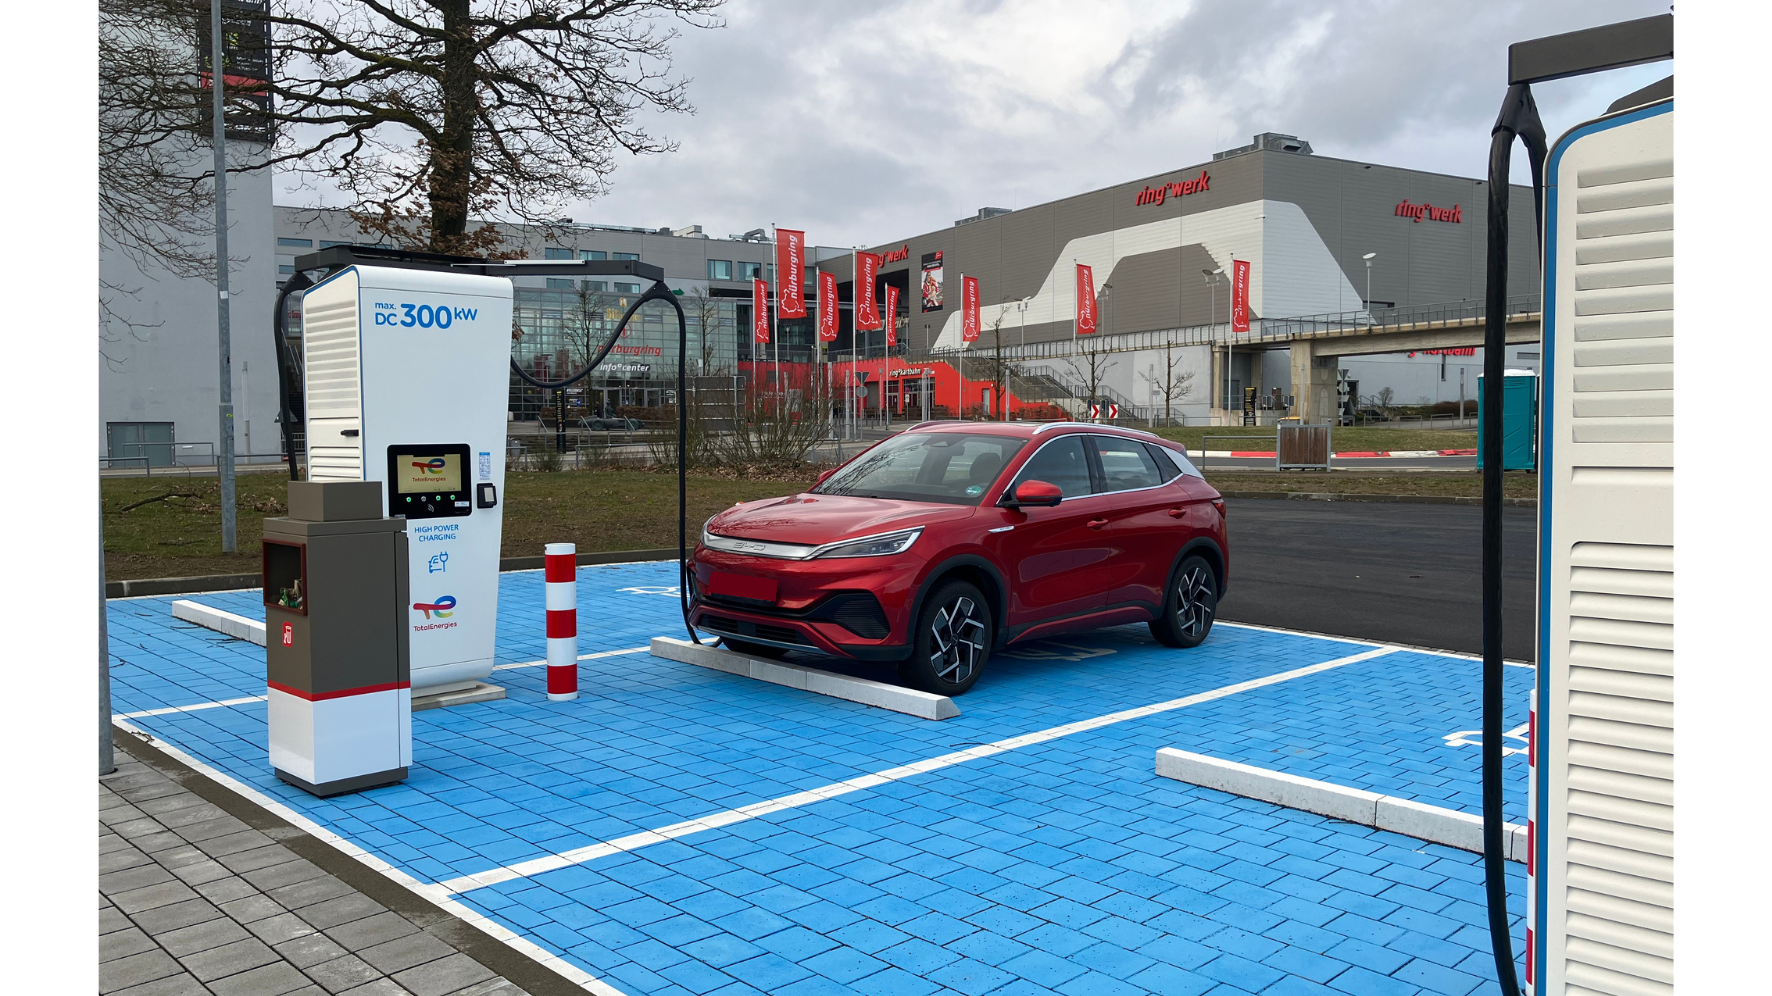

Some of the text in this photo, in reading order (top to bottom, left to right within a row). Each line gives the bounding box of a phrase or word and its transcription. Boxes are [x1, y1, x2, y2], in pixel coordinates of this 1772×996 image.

[788, 234, 799, 300] nürburgring
[374, 302, 397, 310] max.
[826, 276, 835, 327] nürburgring
[375, 303, 478, 329] DC 300 kW
[414, 523, 459, 534] HIGH POWER
[418, 532, 457, 542] CHARGING
[413, 621, 458, 632] TotalEnergies
